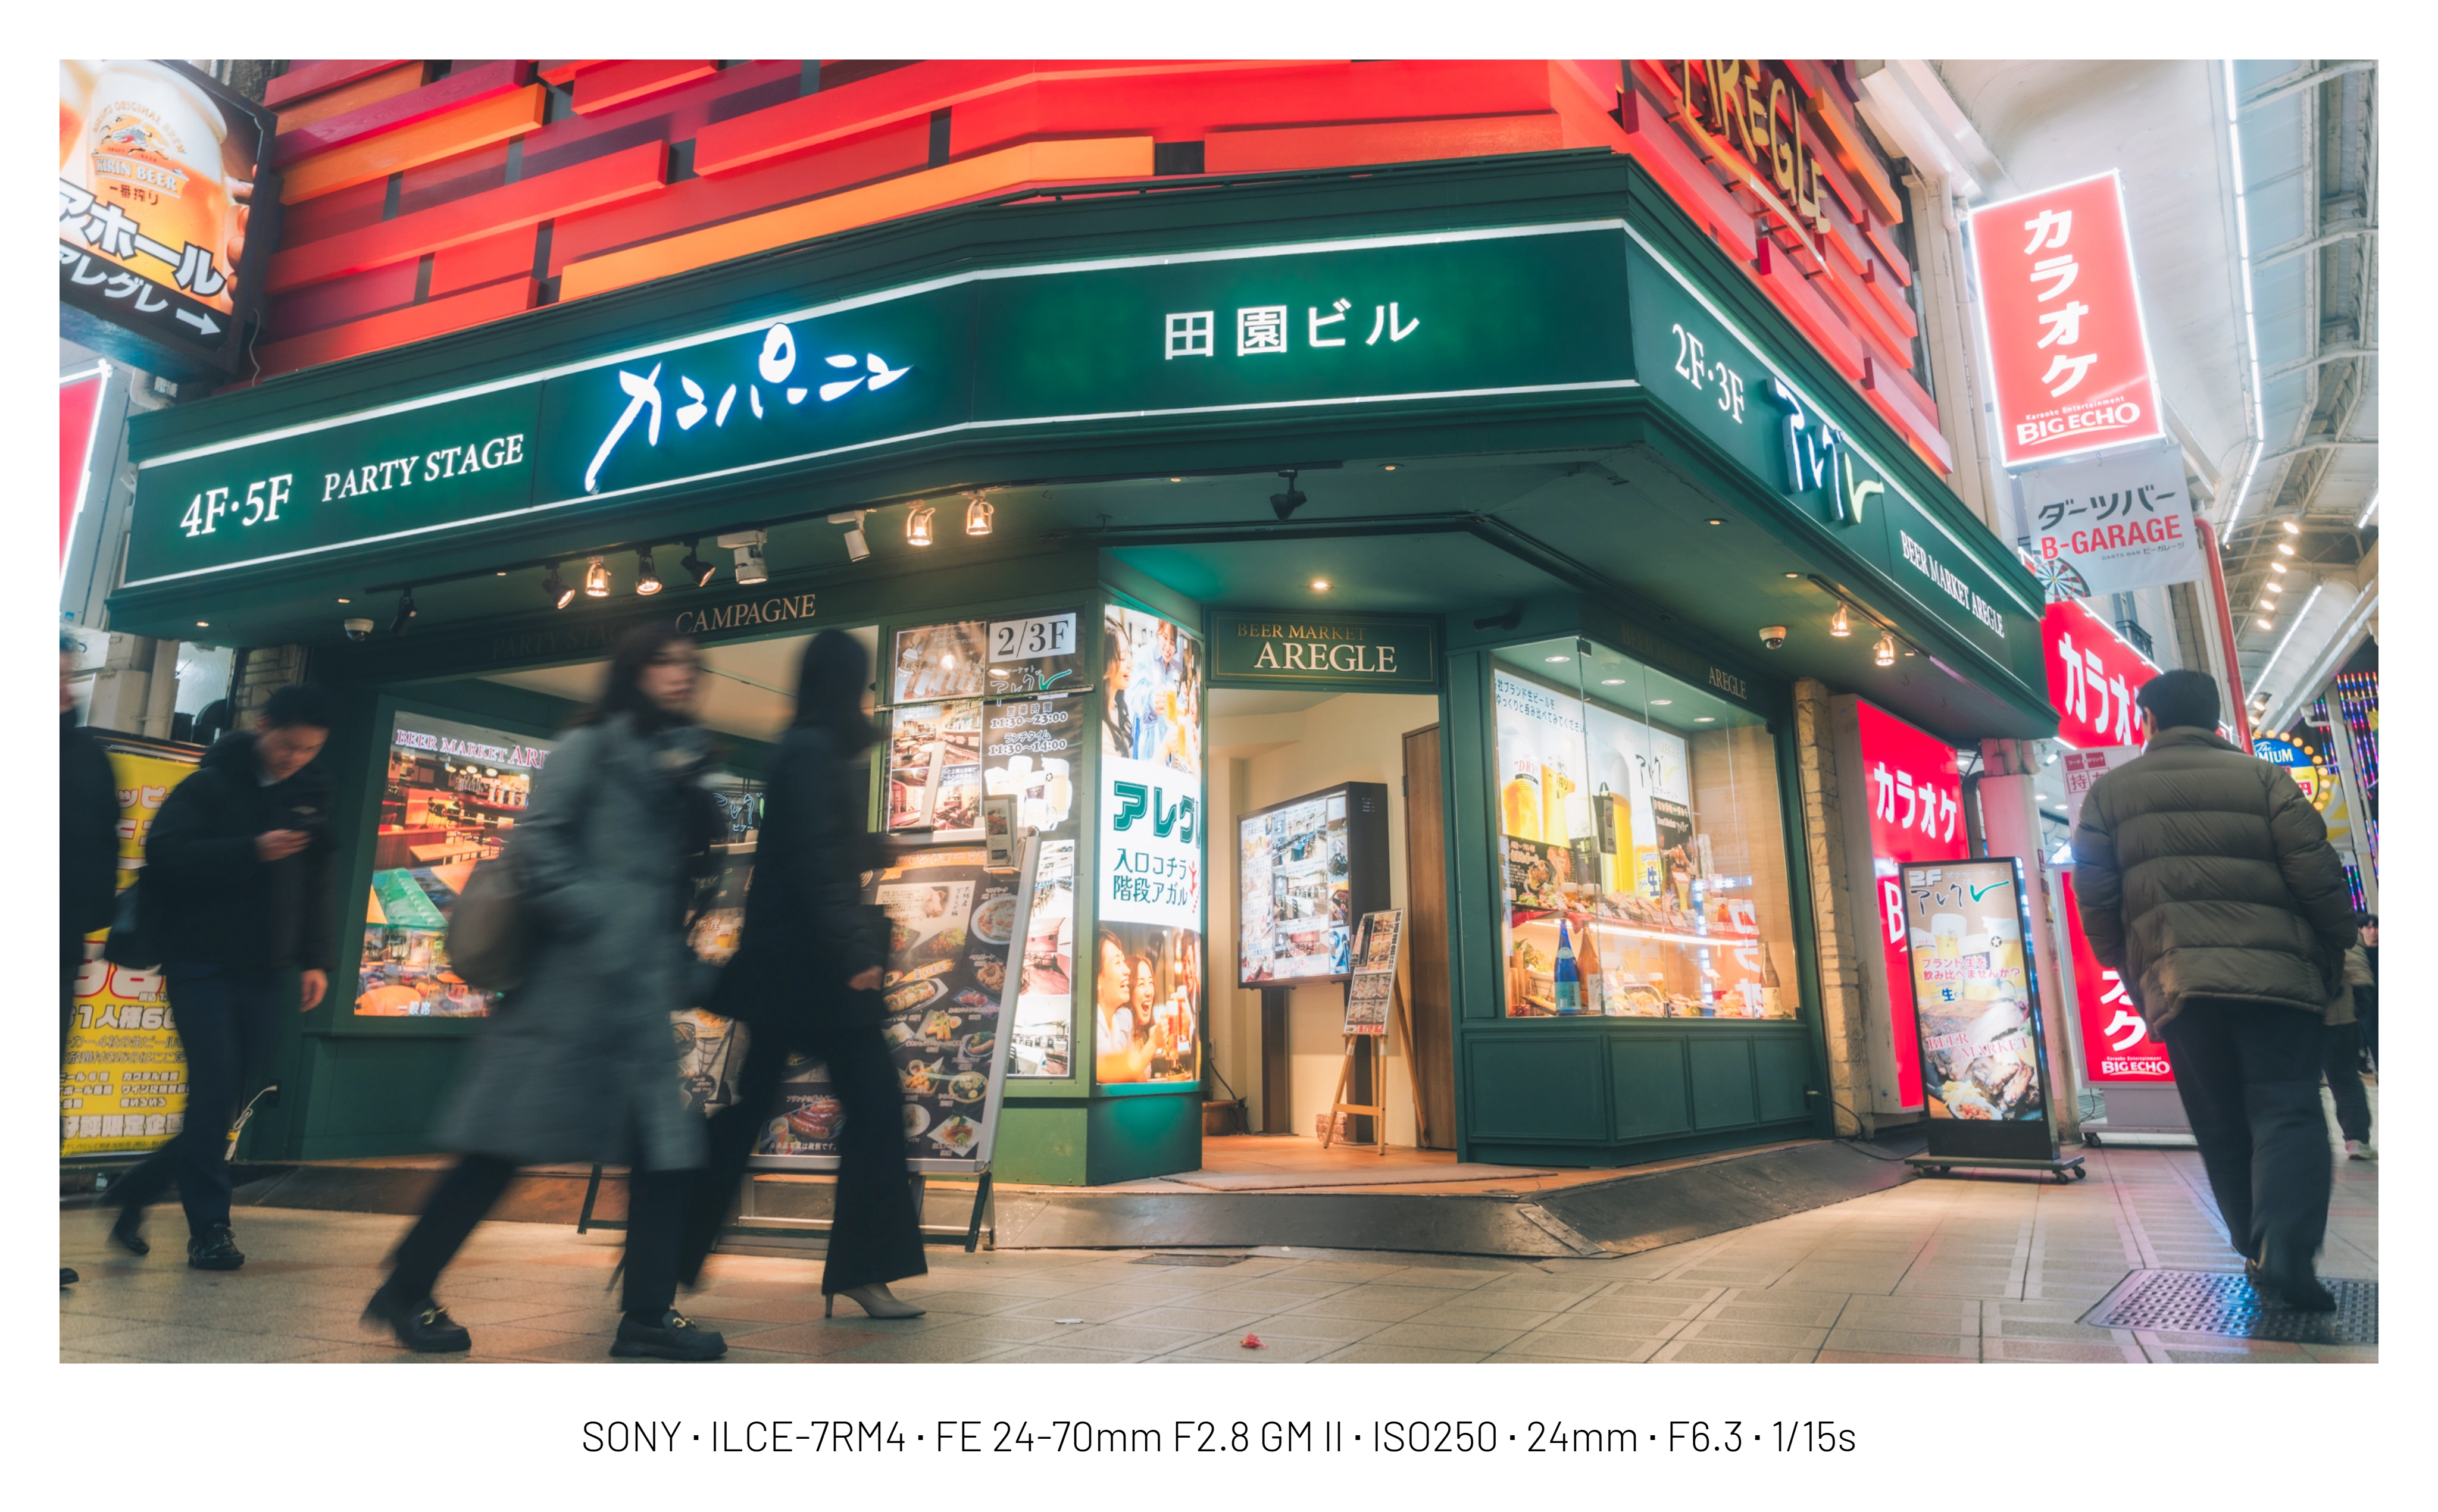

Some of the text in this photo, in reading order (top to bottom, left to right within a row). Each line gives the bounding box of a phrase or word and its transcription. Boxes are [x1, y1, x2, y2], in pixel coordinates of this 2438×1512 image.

[114, 101, 161, 124] ORIGINAL
[162, 122, 187, 155] BREW
[96, 158, 177, 192] KIRIN BEER
[110, 184, 158, 205] 一番搾り
[2024, 209, 2098, 398] カラオケ
[1164, 298, 1420, 361] 田園ビル
[2017, 402, 2140, 446] BIG ECHO
[2026, 395, 2124, 421] Karaoke Entertainment
[321, 434, 524, 502] PARTY STAGE
[2037, 484, 2176, 531] ダーツバー
[2040, 514, 2183, 560] B-GARAGE
[2102, 552, 2125, 561] DARTS
[1899, 528, 2005, 640] BEER MARKET AREGLE
[675, 594, 817, 635] CAMPAGNE
[998, 619, 1069, 659] 2/3F
[1237, 623, 1367, 641] BEER MARKET
[1007, 665, 1035, 674] マーケット
[1254, 641, 1398, 674] AREGLE
[1495, 678, 1555, 710] 社ブランド生ビールを
[1708, 666, 1748, 700] AREGLE
[1007, 702, 1052, 717] 営業時間
[396, 730, 436, 751] BEER
[440, 737, 508, 763] MARKET
[1004, 730, 1052, 743] ランチタイム
[2255, 748, 2294, 763] MIUM
[1874, 762, 1956, 844] カラオケ
[1113, 847, 1187, 881] 入口コチラ
[1909, 869, 1942, 887] 2F
[1113, 875, 1188, 907] 階段アガル
[1921, 957, 1987, 969] ブランド生を
[397, 1001, 432, 1016] 一般席
[1942, 988, 1955, 1002] 生
[1928, 1033, 1969, 1051] BEER
[1961, 1035, 2031, 1060] MARKET
[2102, 1060, 2170, 1075] BIG ECHO
